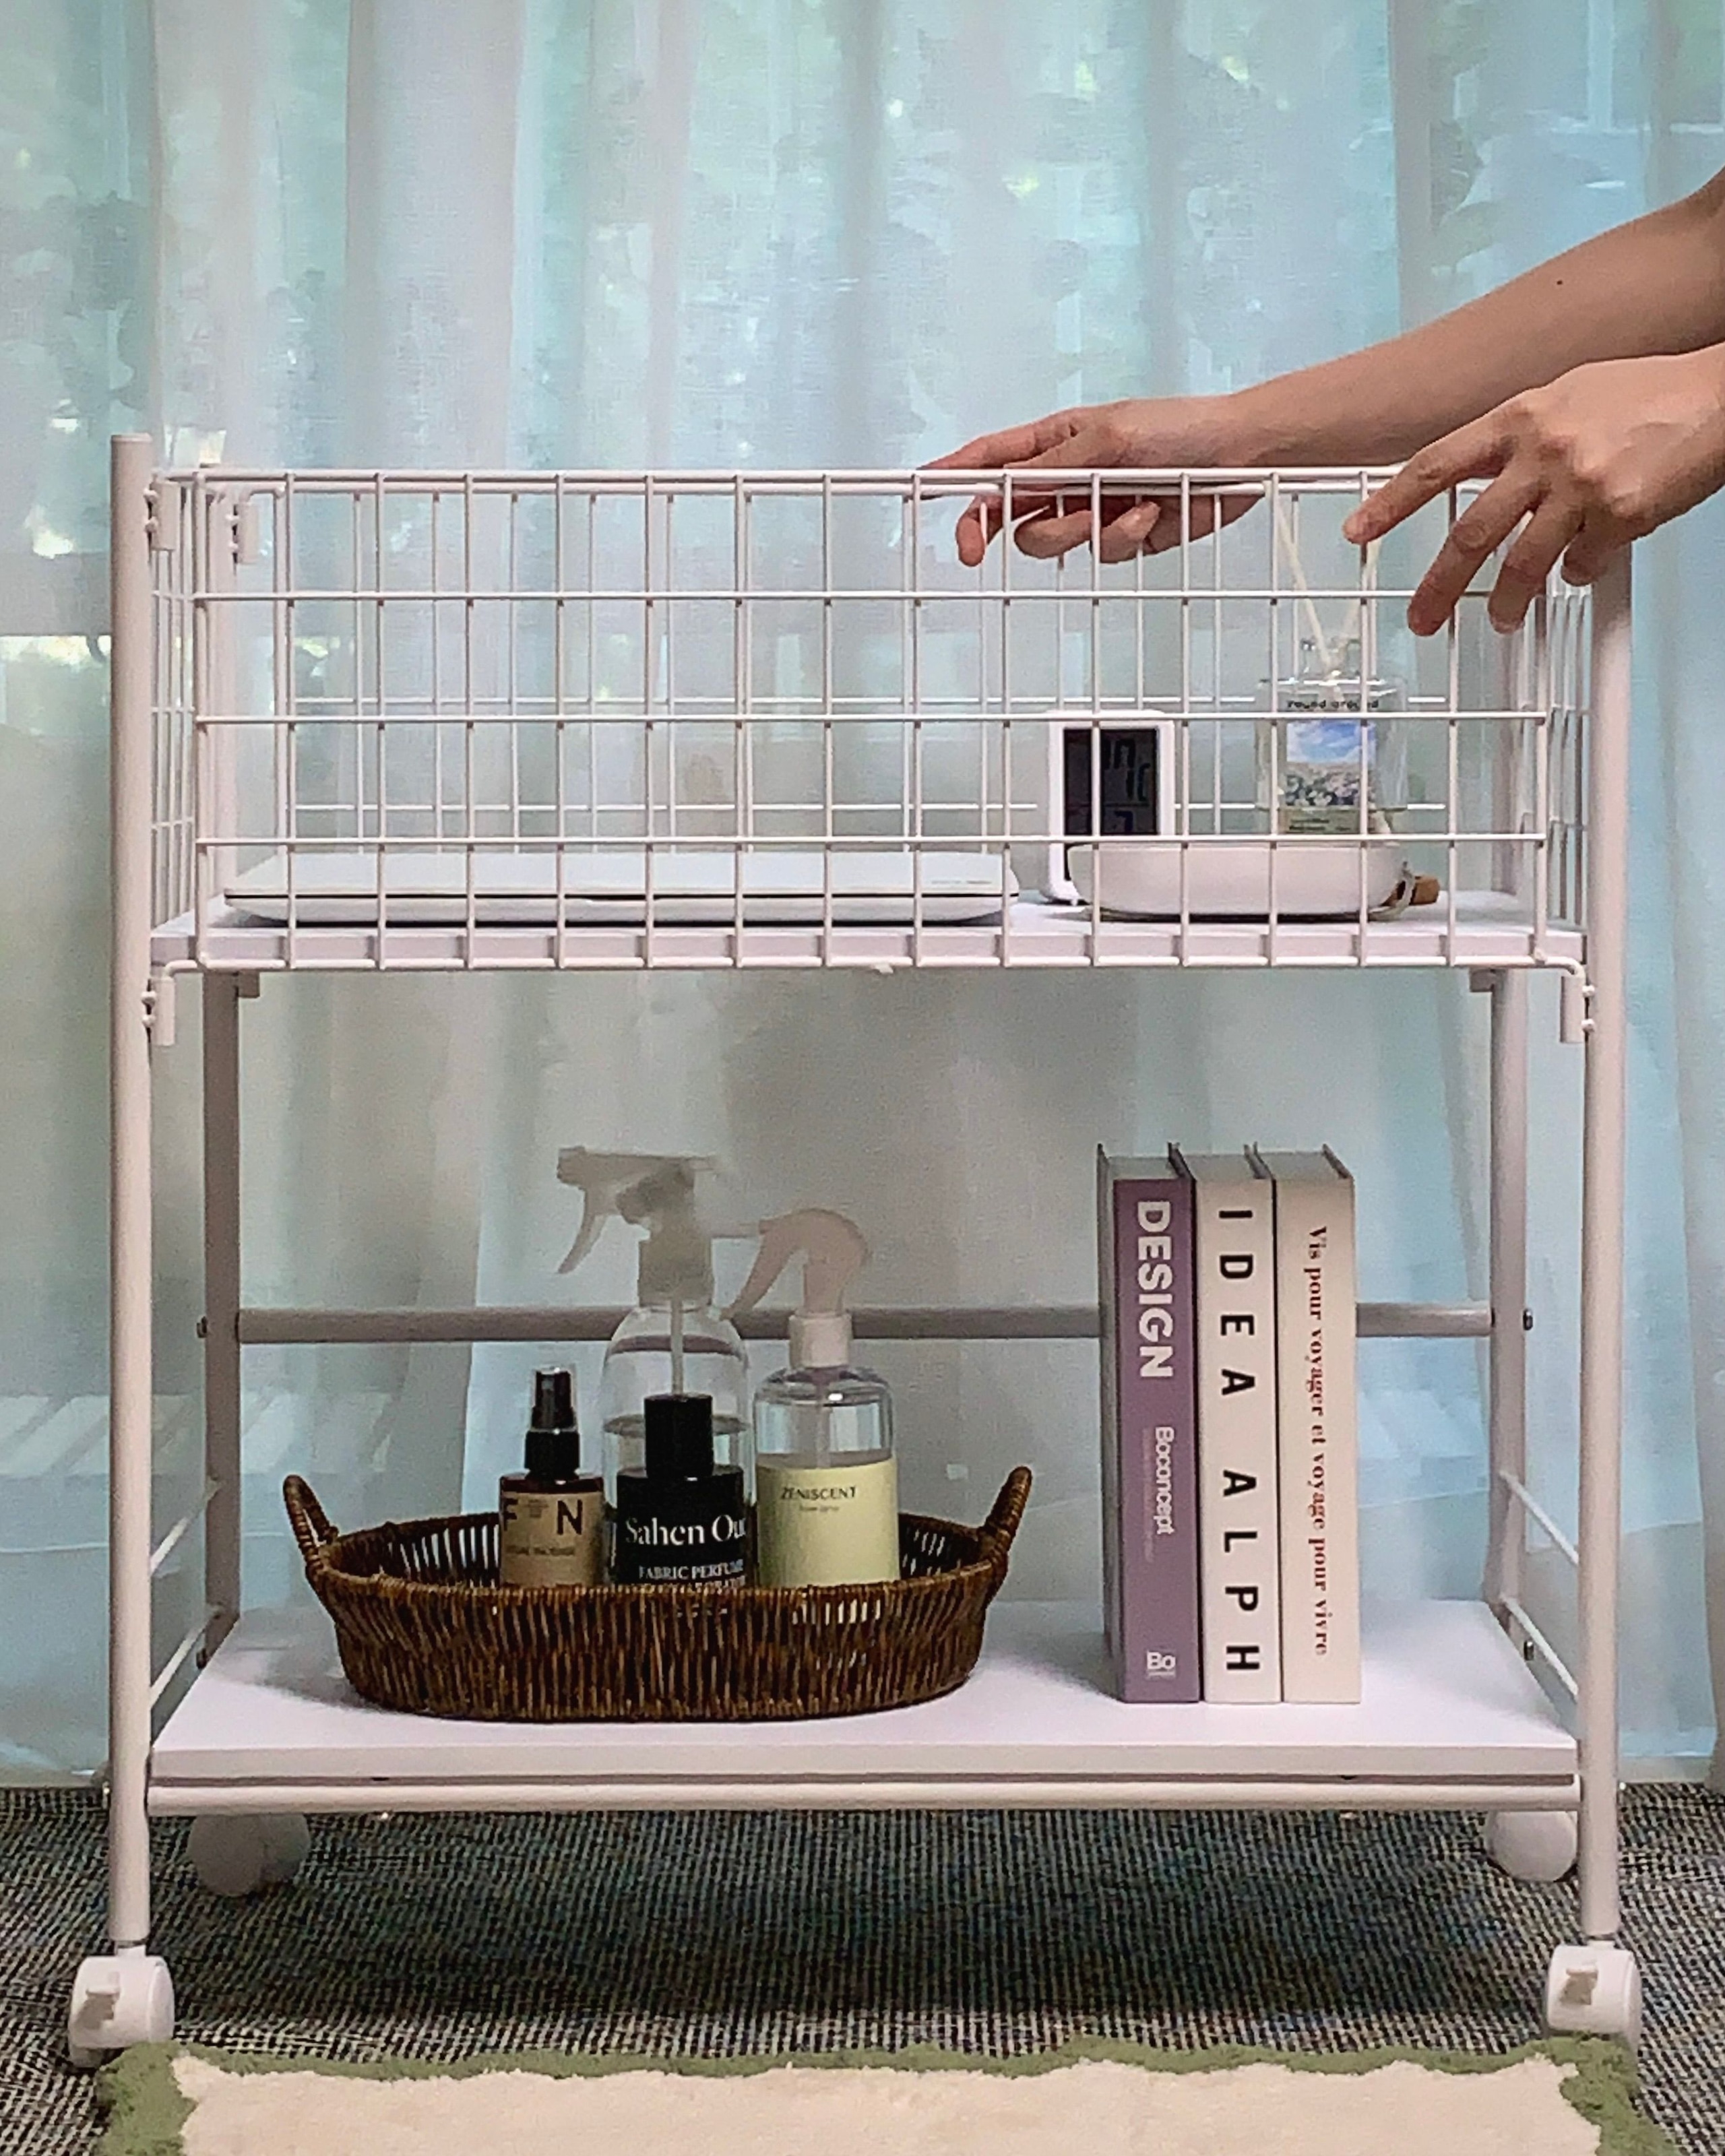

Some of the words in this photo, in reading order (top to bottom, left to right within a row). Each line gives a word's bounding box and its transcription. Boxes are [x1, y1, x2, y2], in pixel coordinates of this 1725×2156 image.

[1308, 1226, 1327, 1260] Vis
[1137, 1201, 1174, 1378] DESIGN
[1218, 1209, 1255, 1396] IDEA
[1304, 1267, 1322, 1321] pour
[1305, 1329, 1323, 1416] voyager
[1311, 1424, 1326, 1444] et
[557, 1499, 583, 1535] N
[1307, 1453, 1325, 1529] voyage
[639, 1565, 689, 1580] FABRIC
[1222, 1469, 1260, 1671] ALPH
[1309, 1538, 1326, 1591] pour
[1315, 1599, 1333, 1655] vivre
[1146, 1651, 1176, 1670] Bo
